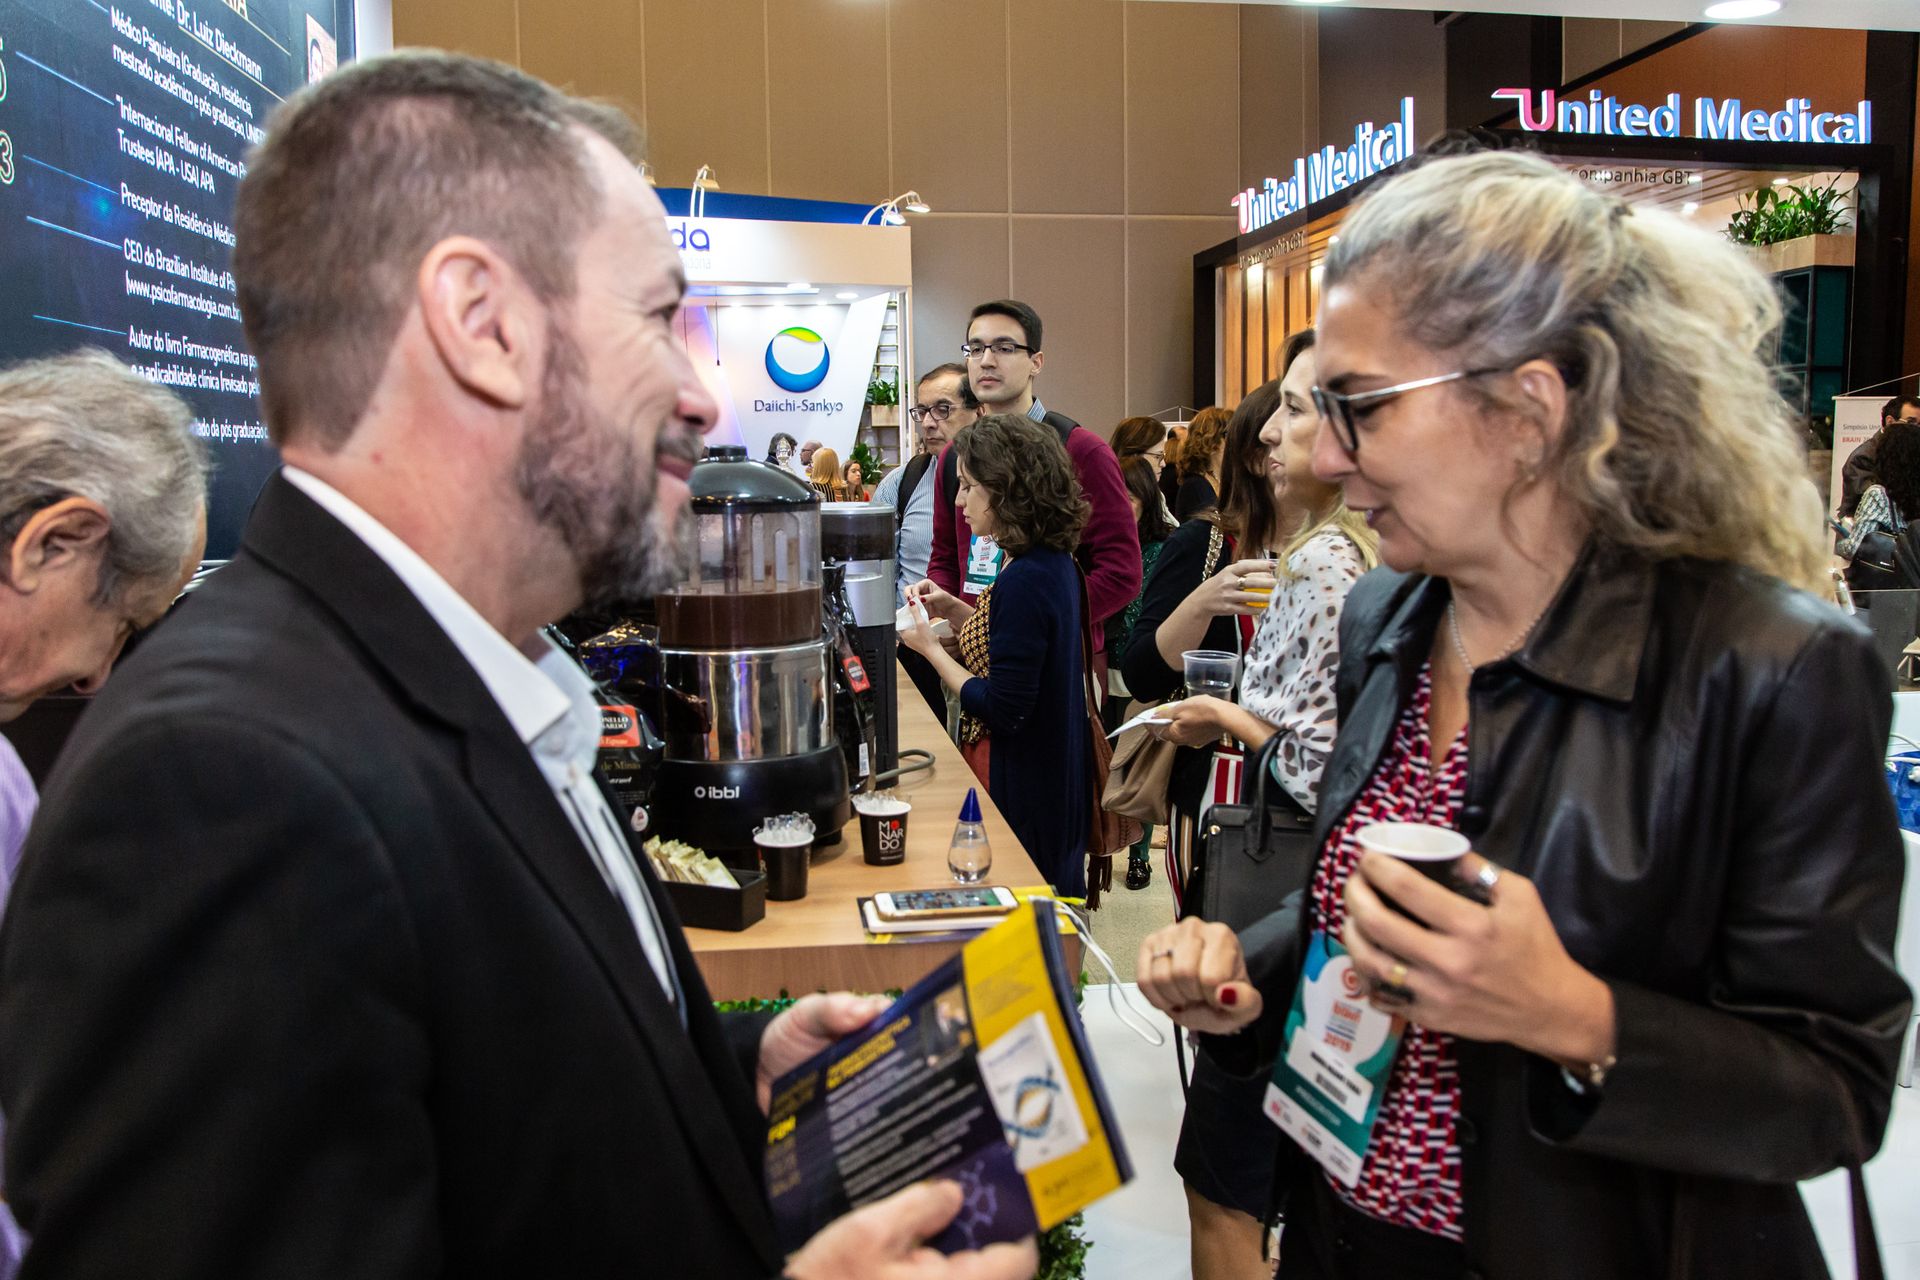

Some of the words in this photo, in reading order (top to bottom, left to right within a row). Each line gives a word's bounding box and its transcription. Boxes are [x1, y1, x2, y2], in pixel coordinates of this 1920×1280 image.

[111, 5, 142, 45] Médico
[142, 26, 181, 70] Psiquiatra
[221, 86, 253, 119] residência,
[177, 0, 192, 31] Dr.
[193, 11, 214, 48] Luiz
[215, 27, 263, 82] Dieckmann
[113, 44, 153, 79] mestrado
[154, 70, 193, 105] acadêmico
[194, 93, 199, 109] e
[199, 95, 212, 117] pós
[1491, 88, 1680, 138] United
[1695, 97, 1872, 144] Medical
[117, 127, 155, 166] Trustees
[155, 146, 176, 176] (APA
[180, 159, 199, 189] USA)
[200, 169, 215, 194] APA
[175, 126, 198, 157] Fellow
[200, 142, 208, 161] of
[208, 145, 238, 177] American
[1231, 157, 1306, 235] United
[1308, 96, 1414, 205] Medical
[1662, 168, 1693, 185] GBT
[120, 182, 162, 220] Preceptor
[163, 201, 173, 223] da
[174, 204, 212, 238] Residência
[124, 238, 143, 264] CEO
[144, 245, 155, 267] do
[156, 248, 190, 279] Brazilian
[190, 260, 218, 287] Institute
[219, 271, 226, 289] of
[129, 325, 152, 350] Autor
[154, 330, 164, 352] do
[165, 332, 182, 356] livro
[182, 335, 239, 367] Farmacogenética
[240, 353, 248, 367] na
[145, 362, 197, 387] aplicabilidade
[198, 368, 219, 391] clínica
[220, 370, 248, 395] (revisado
[211, 417, 220, 437] da
[221, 418, 232, 443] pós
[232, 420, 264, 444] graduação
[754, 399, 843, 416] Daiichi-Sankyo
[708, 786, 740, 799] ibbl
[880, 839, 900, 850] DO
